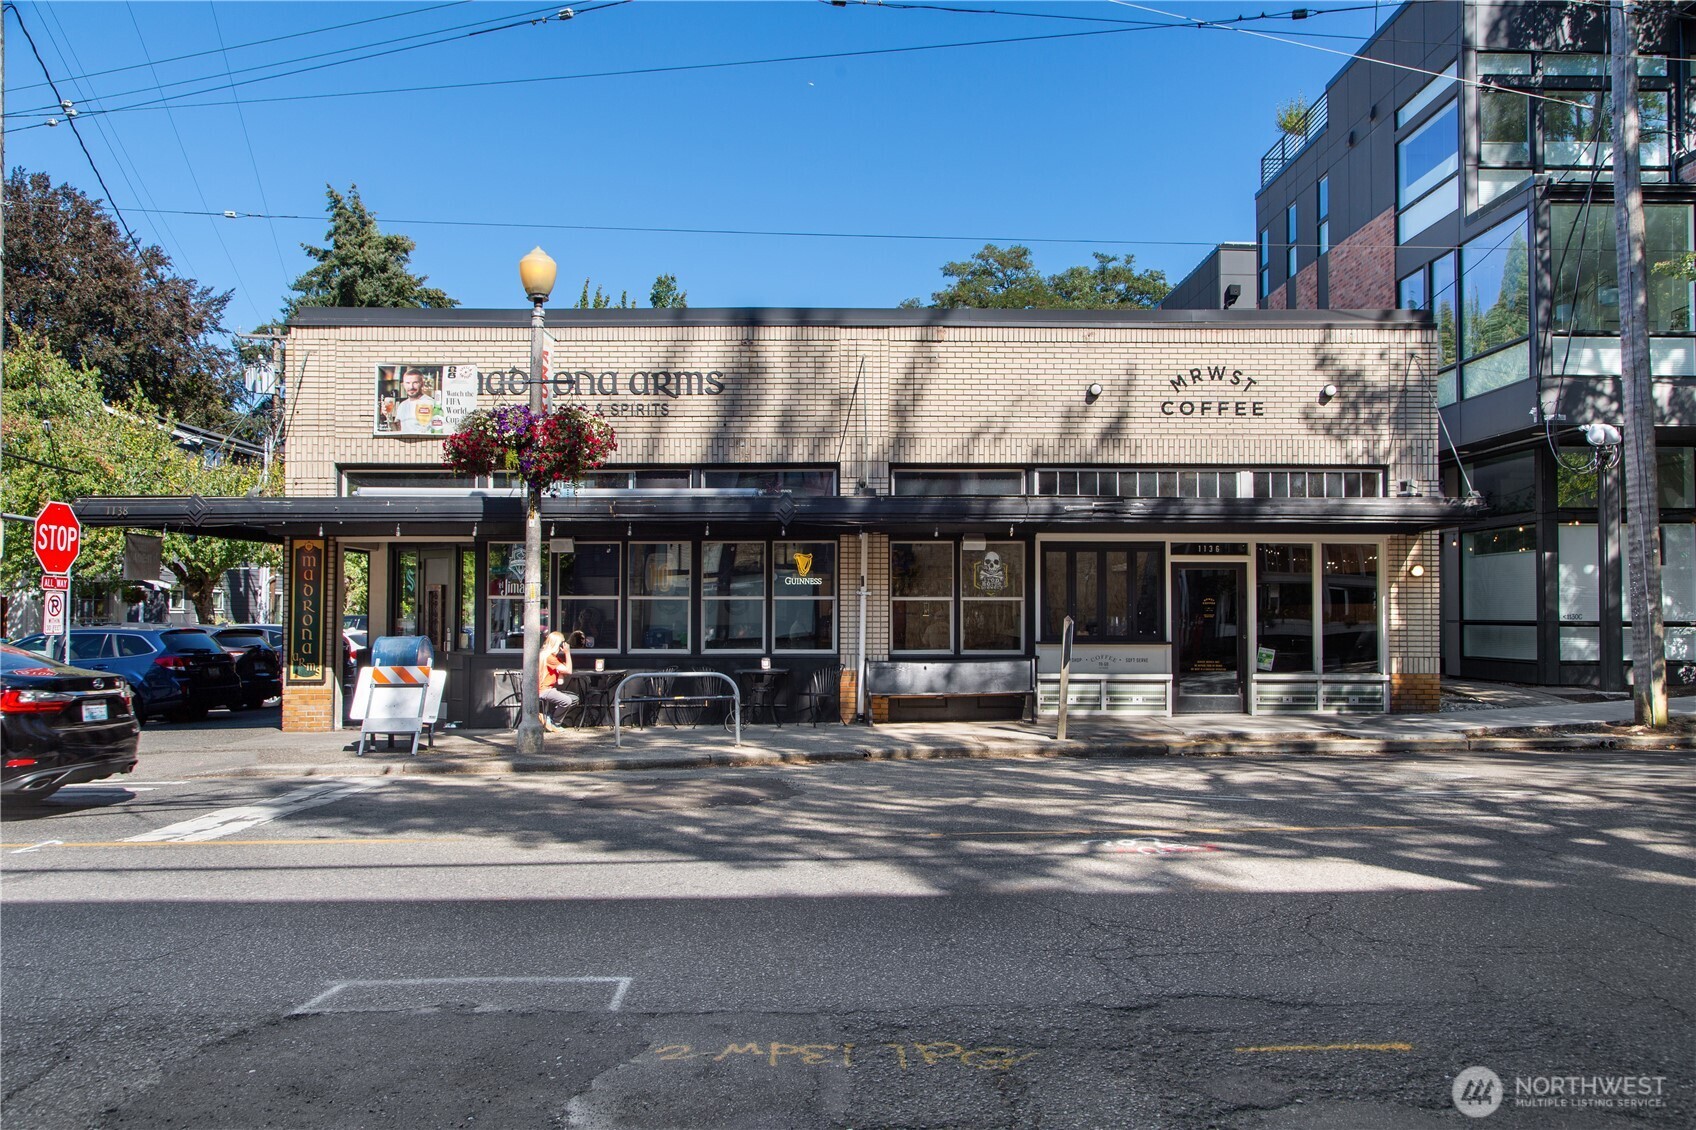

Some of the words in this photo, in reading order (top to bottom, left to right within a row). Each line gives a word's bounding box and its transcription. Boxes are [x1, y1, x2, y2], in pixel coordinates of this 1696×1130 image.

[1170, 366, 1257, 393] MRWST
[446, 406, 467, 414] World
[610, 403, 670, 416] SPIRITS
[1161, 401, 1264, 416] COFFEE
[445, 417, 460, 425] Cup
[106, 505, 129, 515] 1138
[37, 523, 77, 552] STOP
[1198, 545, 1220, 553] 1136
[44, 578, 54, 587] ALL
[57, 579, 68, 588] WAY
[1090, 654, 1117, 664] COFFEE
